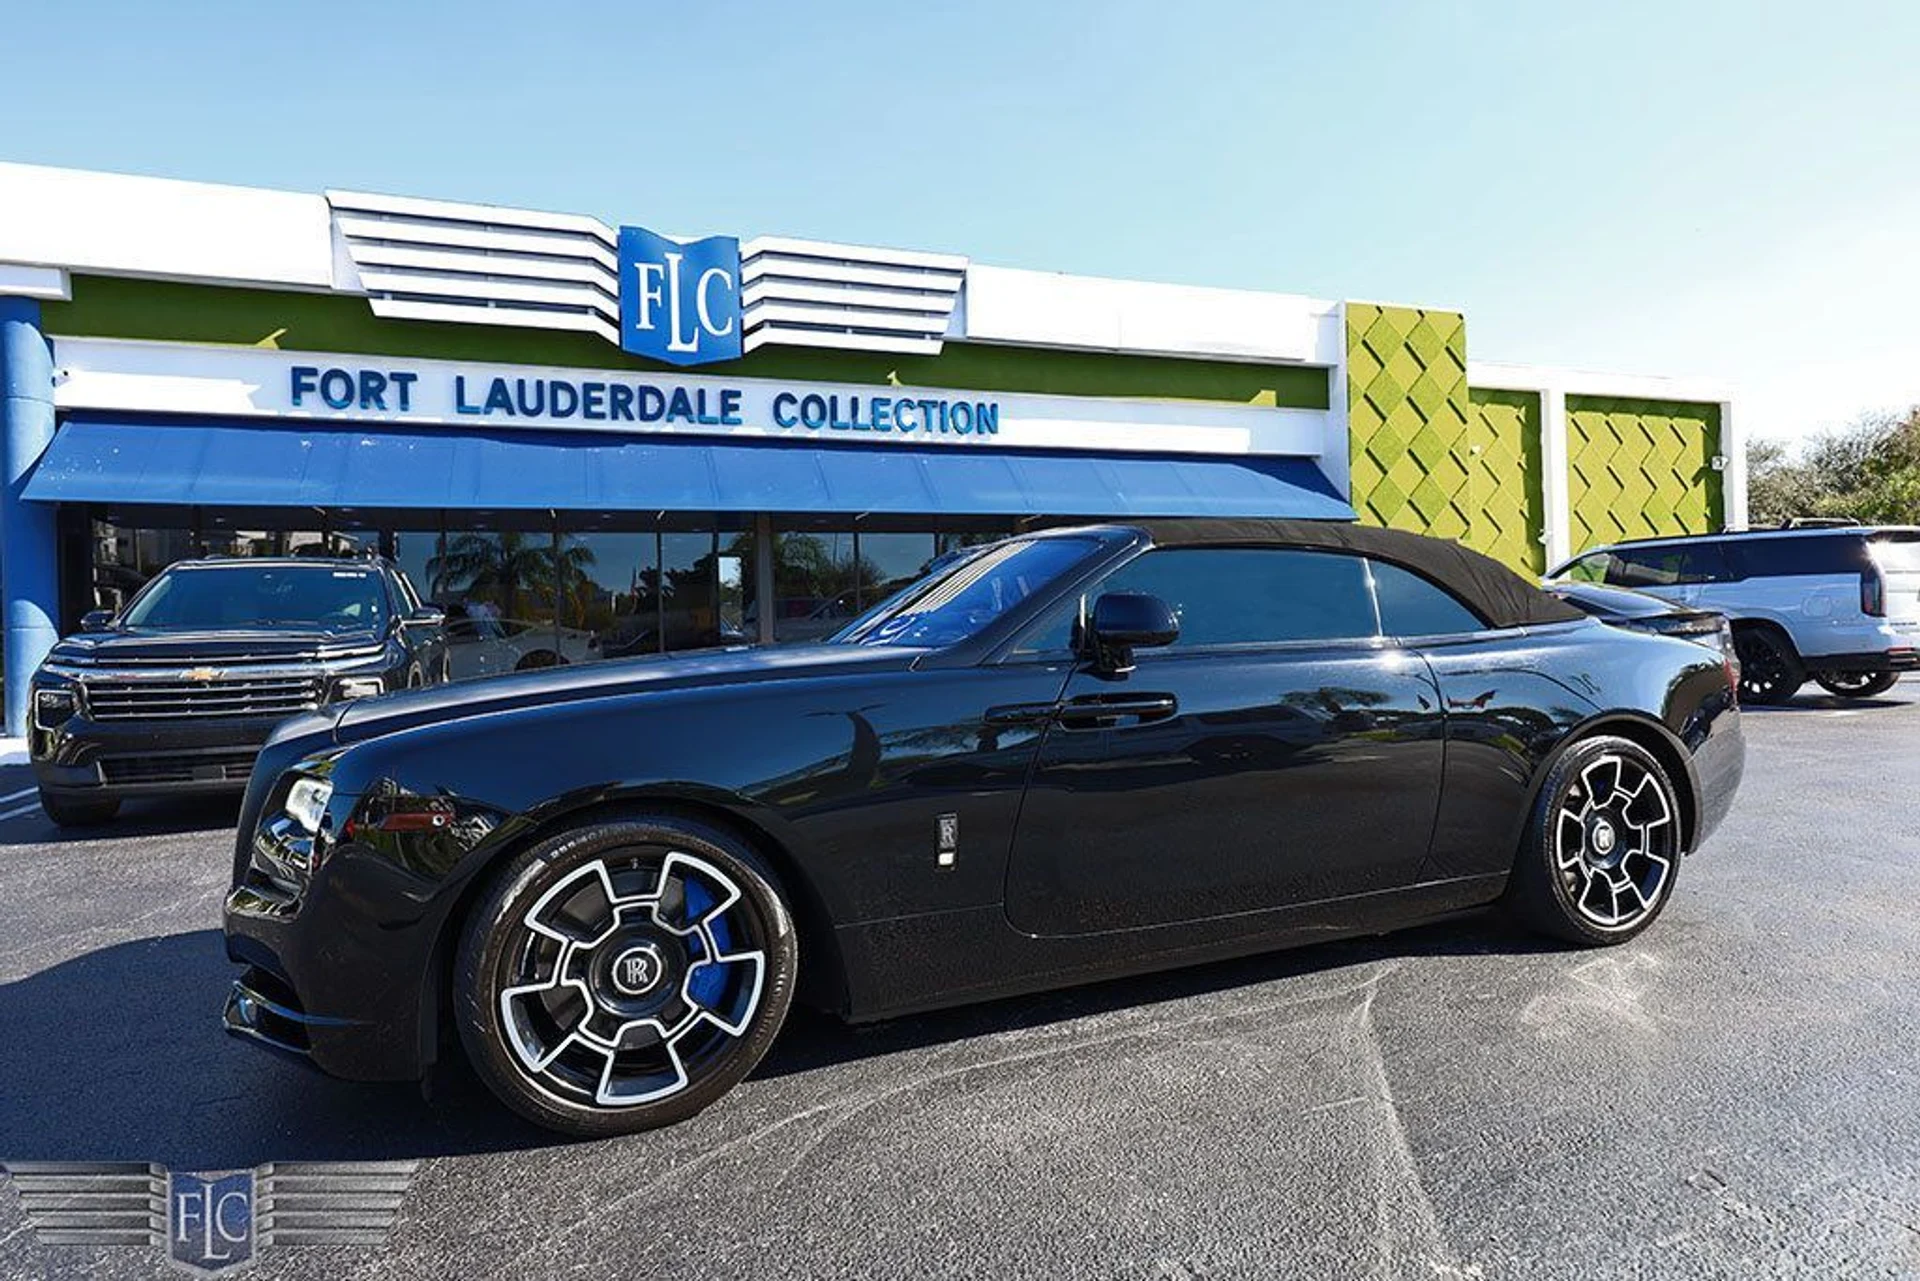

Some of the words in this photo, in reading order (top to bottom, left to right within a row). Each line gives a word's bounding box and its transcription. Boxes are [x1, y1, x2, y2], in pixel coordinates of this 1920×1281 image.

[633, 252, 733, 352] FLC
[291, 366, 418, 411] FORT
[455, 375, 742, 425] LAUDERDALE
[773, 392, 999, 435] COLLECTION
